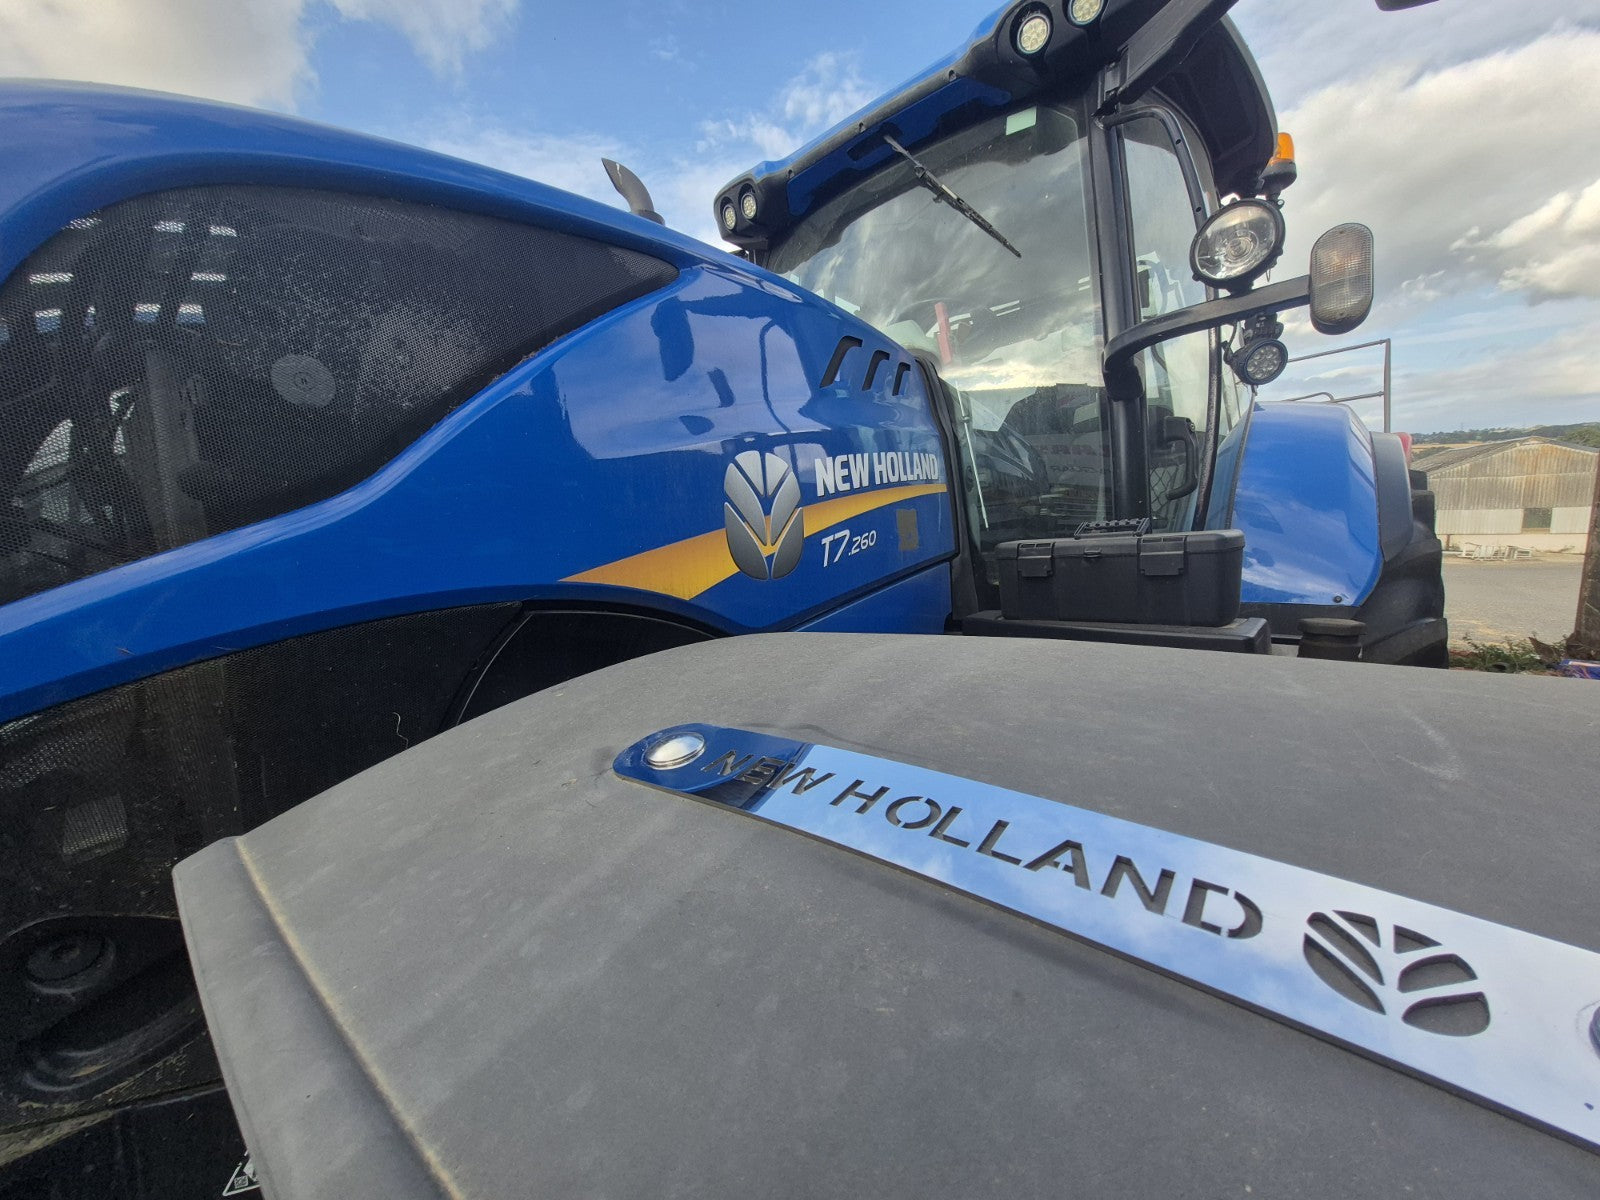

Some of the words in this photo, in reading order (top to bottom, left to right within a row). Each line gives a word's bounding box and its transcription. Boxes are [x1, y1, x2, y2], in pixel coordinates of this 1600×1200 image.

[814, 452, 869, 497] NEW
[874, 451, 939, 486] HOLLAND
[702, 750, 836, 795] NEW
[829, 779, 1263, 939] HOLLAND
